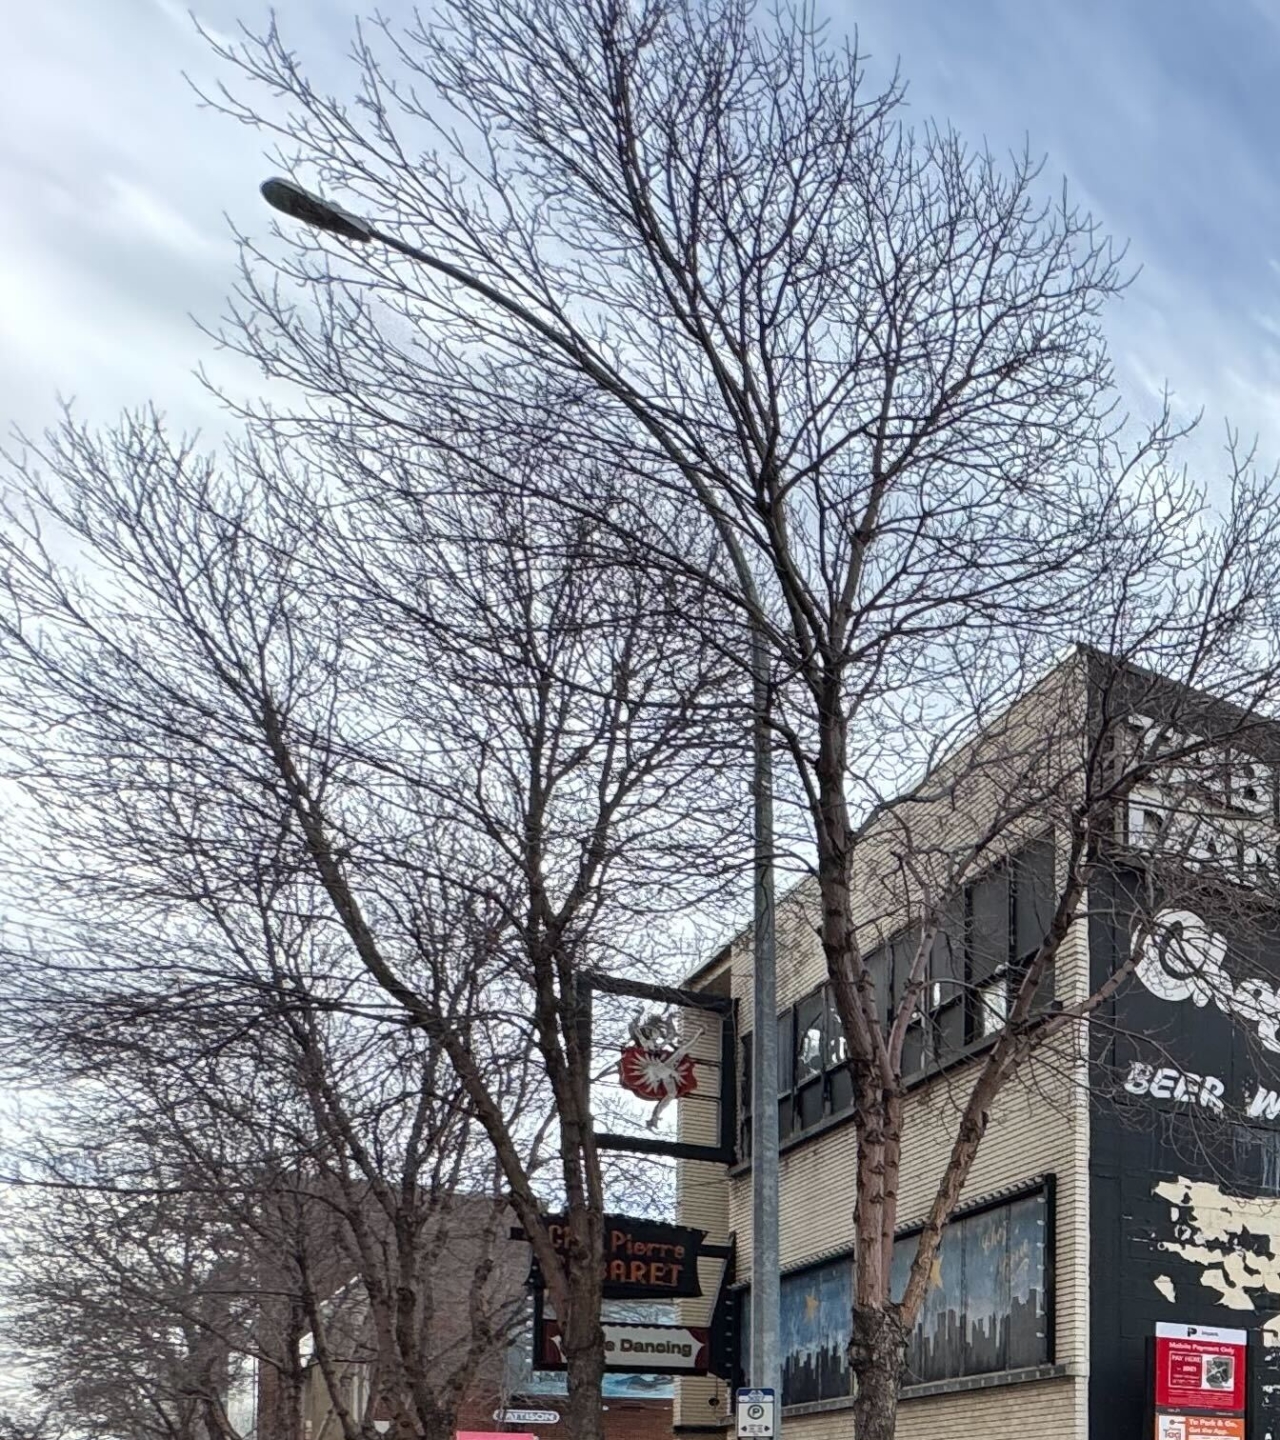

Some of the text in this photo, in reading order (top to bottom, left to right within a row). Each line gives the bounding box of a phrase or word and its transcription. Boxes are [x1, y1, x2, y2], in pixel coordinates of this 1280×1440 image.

[1123, 1060, 1225, 1112] BEER
[609, 1230, 686, 1259] Pierre
[619, 1338, 693, 1358] Dancing
